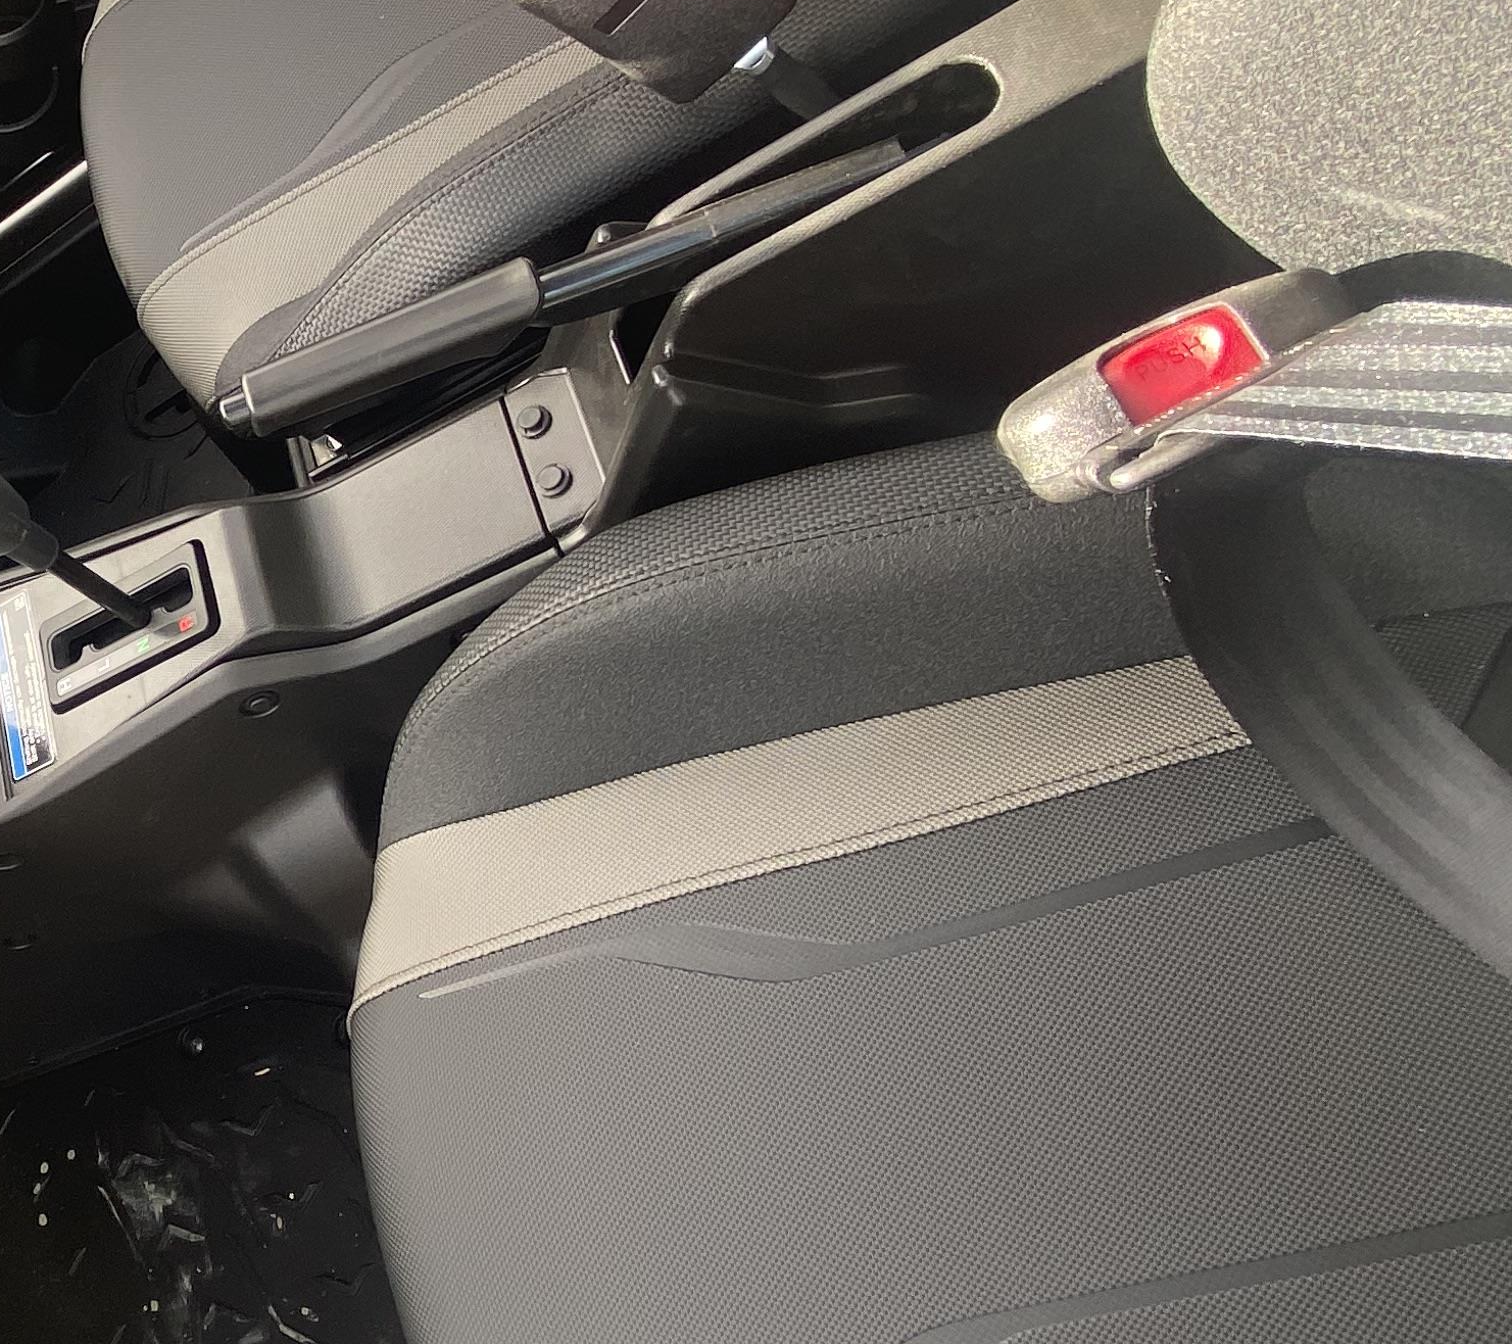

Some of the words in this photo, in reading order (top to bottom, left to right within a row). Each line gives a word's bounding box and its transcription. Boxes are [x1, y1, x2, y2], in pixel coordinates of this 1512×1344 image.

[1133, 334, 1208, 384] PUSH
[137, 634, 150, 654] N
[98, 656, 110, 672] L
[1, 672, 14, 712] NOTICE
